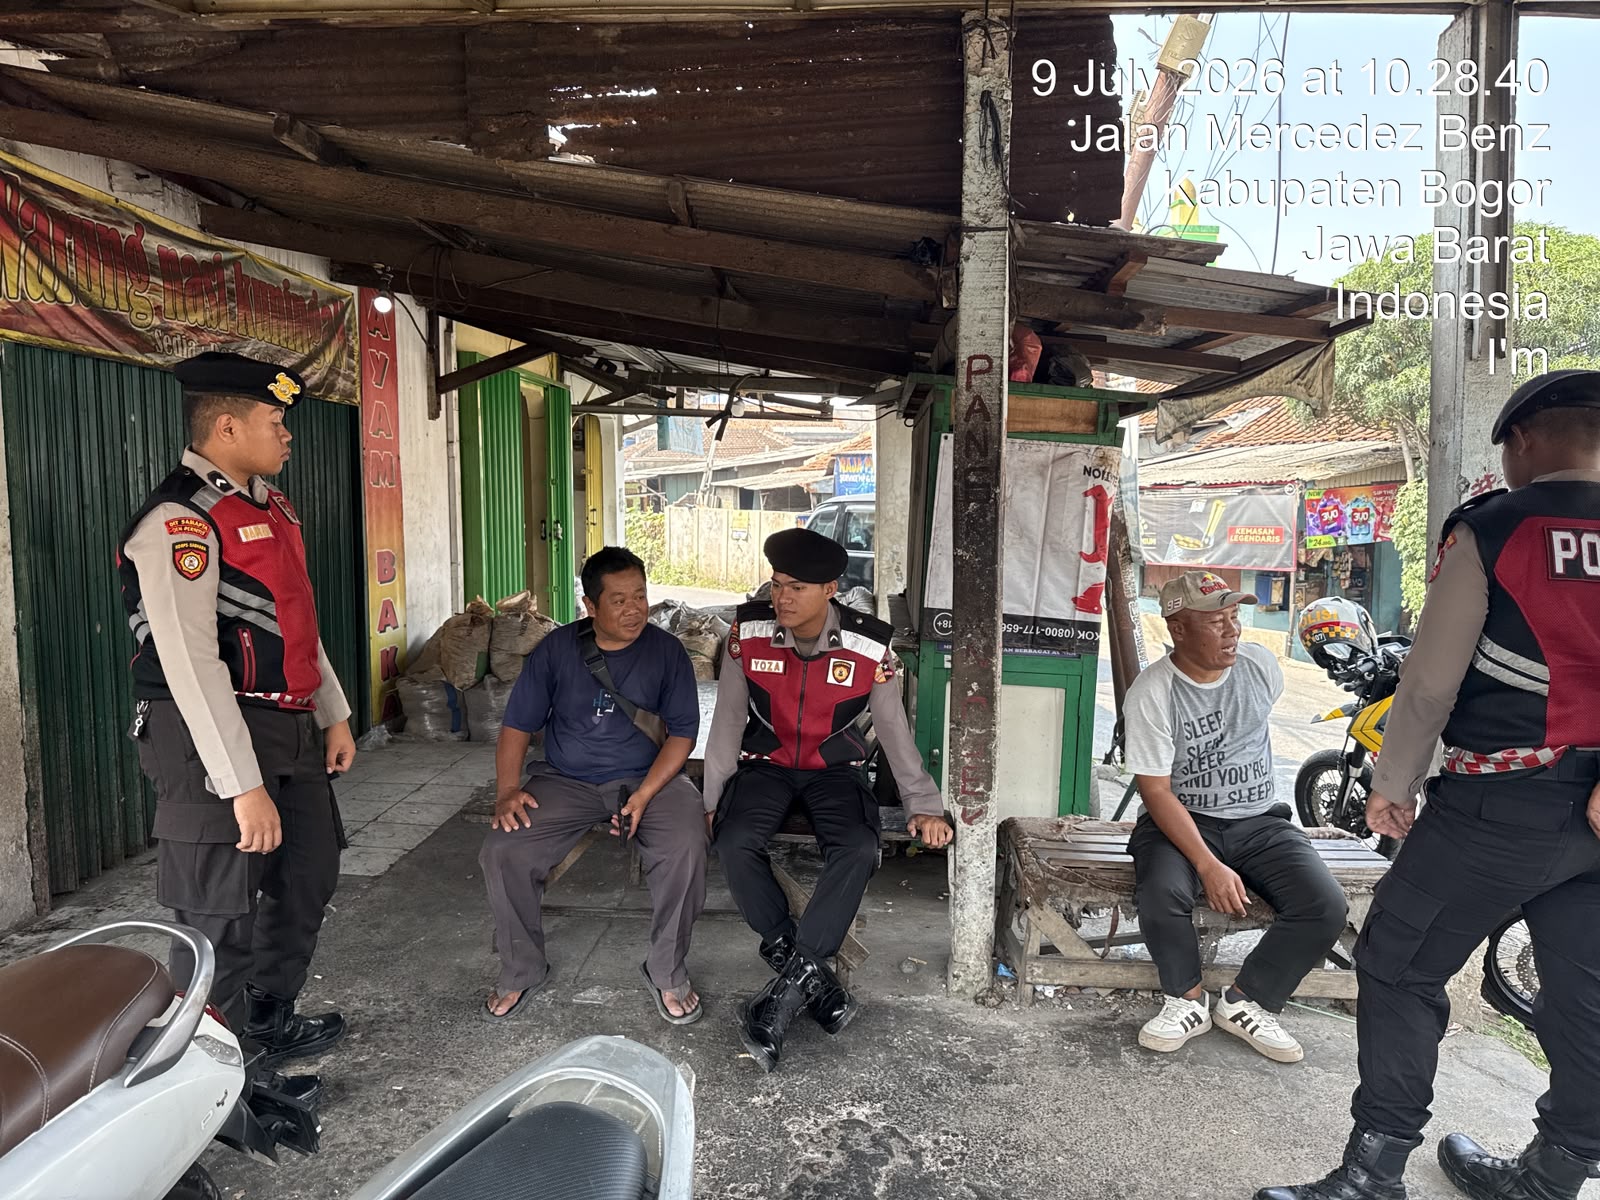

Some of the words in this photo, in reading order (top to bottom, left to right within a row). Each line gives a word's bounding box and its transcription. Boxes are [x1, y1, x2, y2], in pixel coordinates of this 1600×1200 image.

[156, 243, 229, 333] nasi
[367, 300, 396, 488] AYAM
[1229, 535, 1281, 543] LEGENDARIS
[1235, 527, 1275, 535] KEMASAN
[1167, 597, 1183, 610] 93
[375, 549, 403, 721] BAKA
[753, 660, 781, 672] YOZA
[1183, 710, 1226, 741] SLEEP.
[1179, 771, 1212, 788] AND
[1217, 758, 1268, 787] YOU'RE
